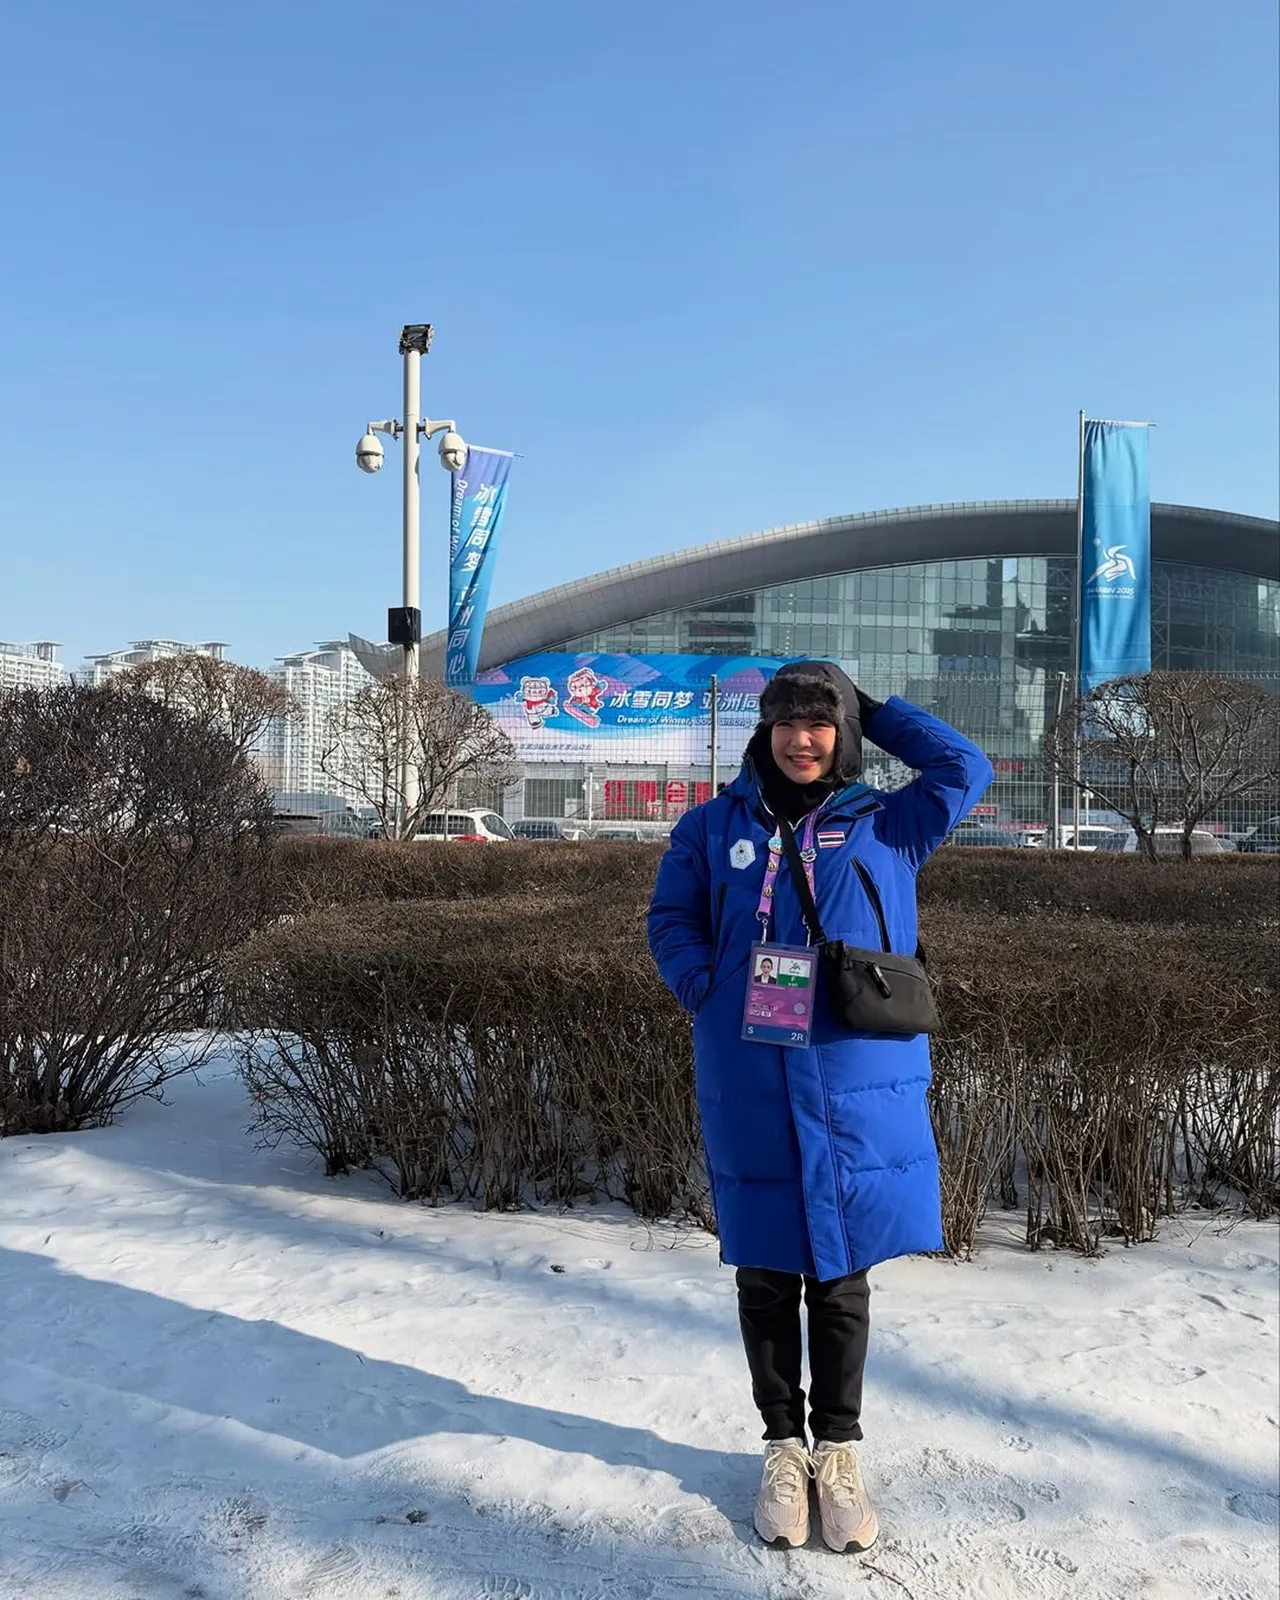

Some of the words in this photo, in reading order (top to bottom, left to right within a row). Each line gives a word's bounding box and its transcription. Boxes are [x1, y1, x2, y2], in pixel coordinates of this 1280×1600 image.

[454, 479, 468, 517] Dream
[452, 520, 461, 534] of
[460, 482, 497, 572] 冰雪同梦
[609, 690, 694, 710] 冰雪同梦
[617, 714, 647, 724] Dream
[649, 715, 659, 724] of
[791, 1033, 804, 1041] 2R
